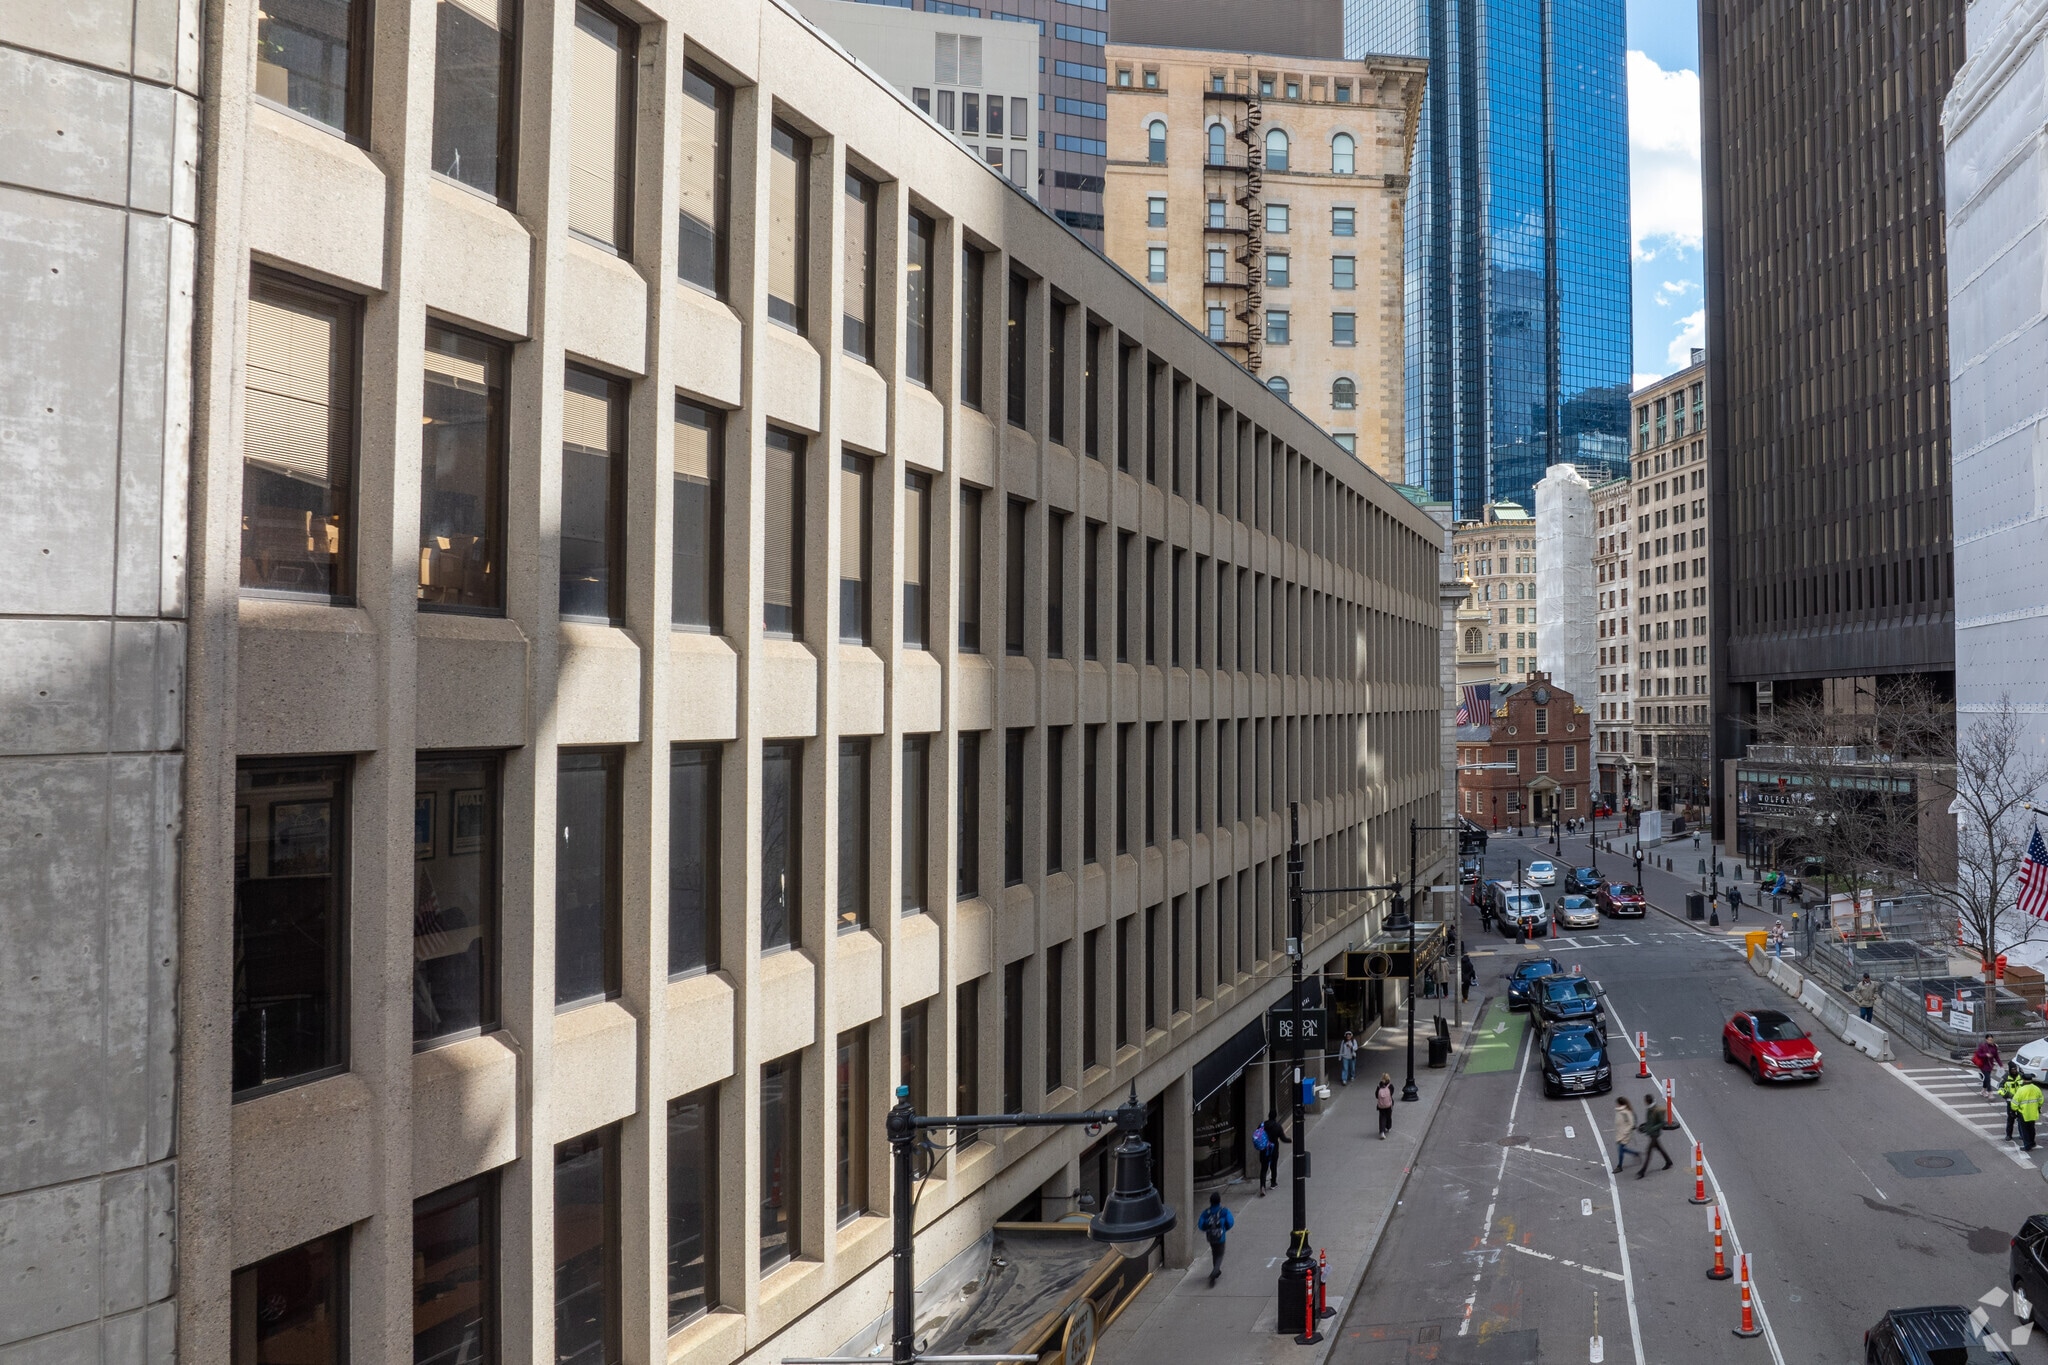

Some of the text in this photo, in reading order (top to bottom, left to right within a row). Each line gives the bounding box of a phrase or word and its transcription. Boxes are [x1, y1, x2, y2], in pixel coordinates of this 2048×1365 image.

[459, 793, 482, 806] WAL
[1279, 1019, 1318, 1028] BOON
[1279, 1027, 1318, 1037] DETAL
[1072, 1326, 1087, 1361] 55
